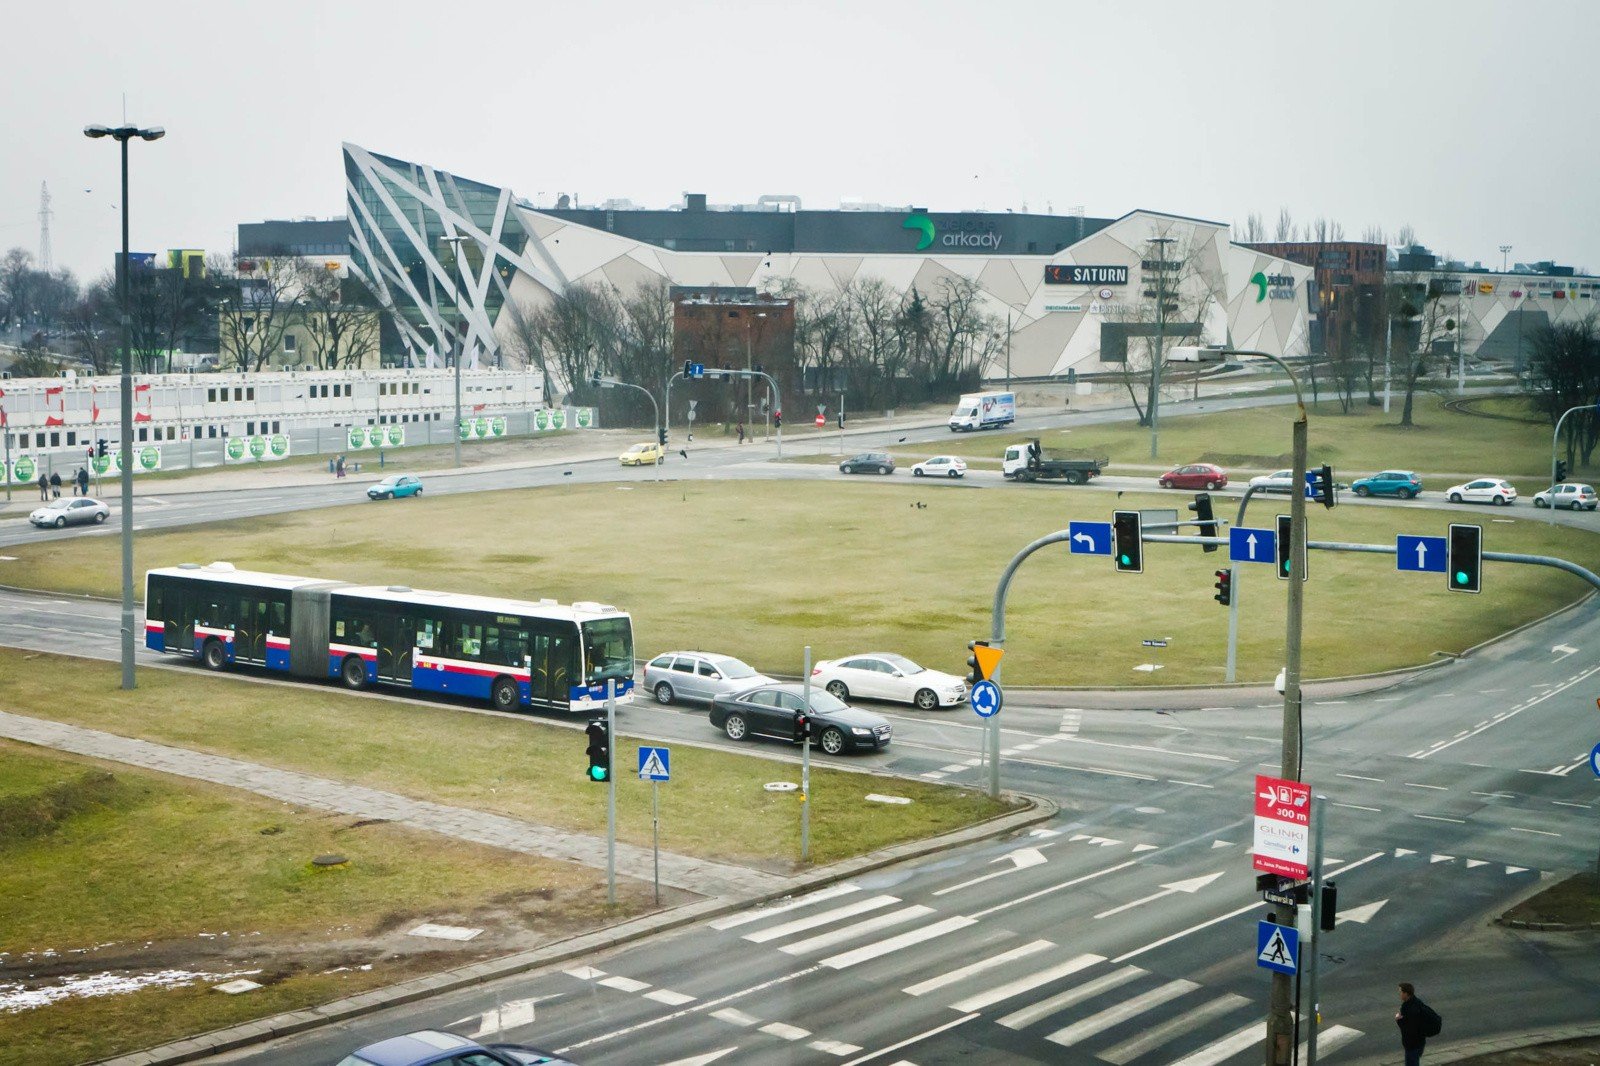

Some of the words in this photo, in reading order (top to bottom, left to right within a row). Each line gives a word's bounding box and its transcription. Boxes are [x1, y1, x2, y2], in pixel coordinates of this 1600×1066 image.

[942, 231, 1002, 250] arkady
[1073, 268, 1126, 282] SATURN
[1276, 808, 1295, 819] 300
[1296, 813, 1307, 822] m
[1260, 825, 1304, 841] GLINKI
